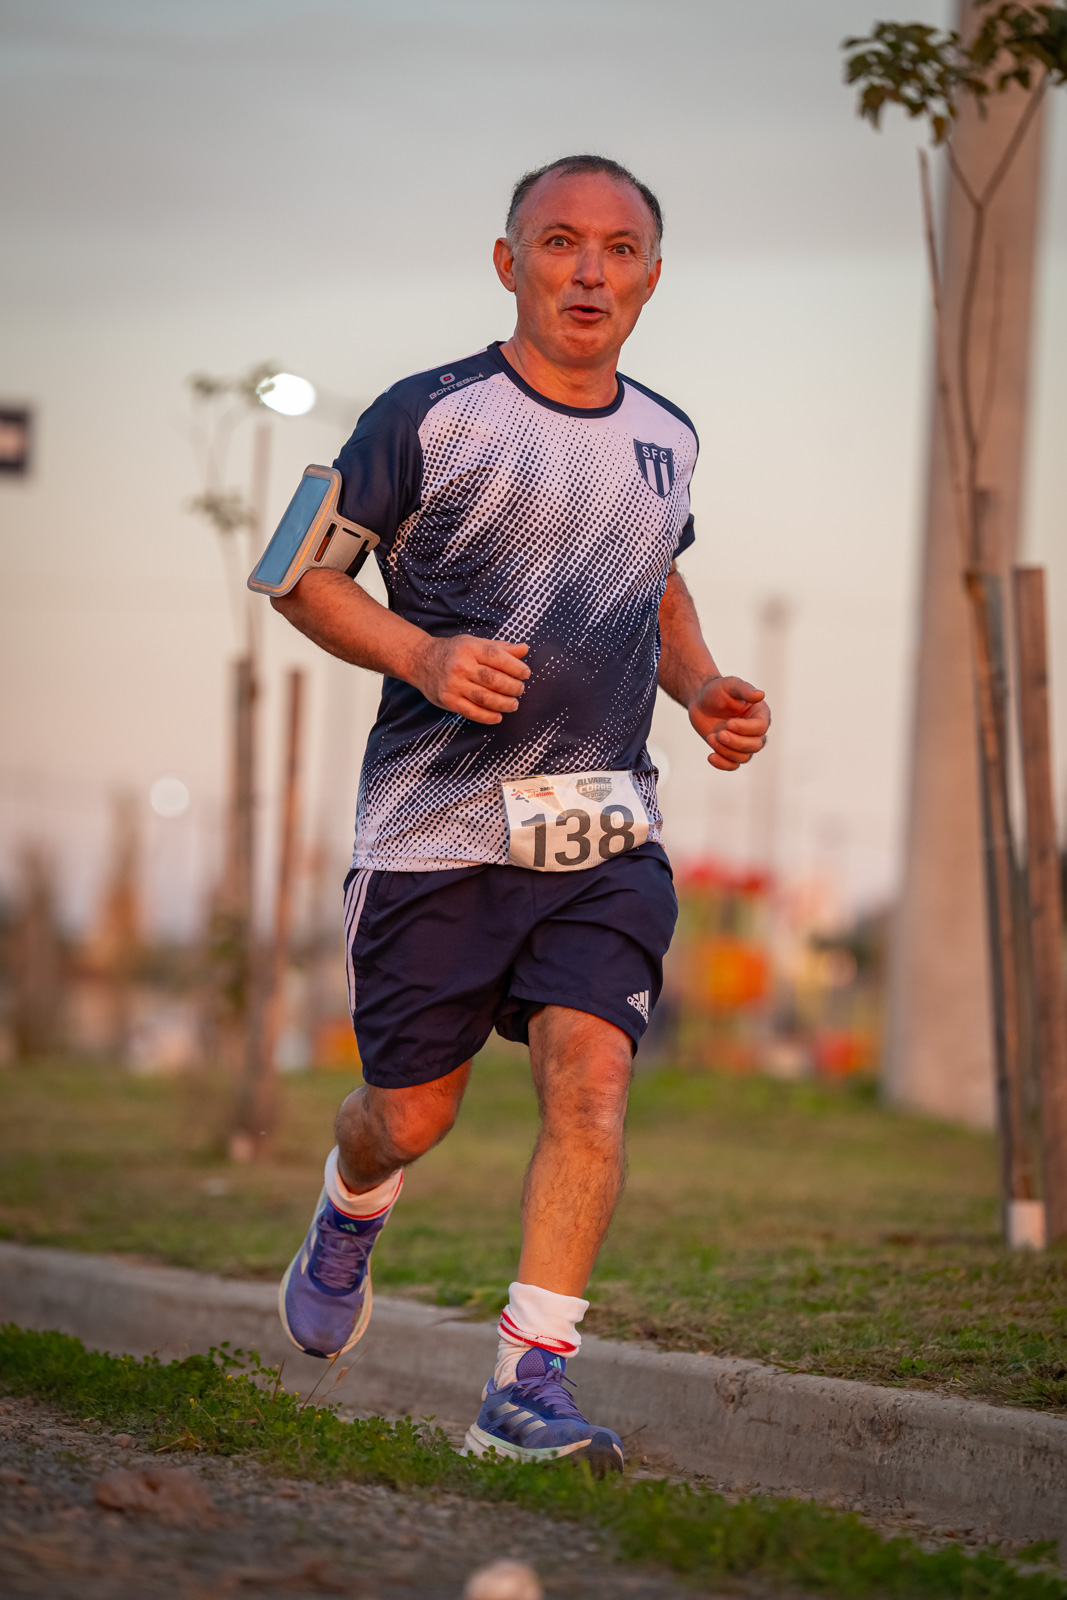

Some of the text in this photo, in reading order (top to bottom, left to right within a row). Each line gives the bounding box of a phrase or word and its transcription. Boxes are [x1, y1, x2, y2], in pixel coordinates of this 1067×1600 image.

[642, 446, 668, 463] SFC
[577, 777, 612, 787] ALVAREZ
[579, 783, 612, 794] CORRE
[520, 804, 635, 867] 138
[627, 996, 648, 1023] adidas
